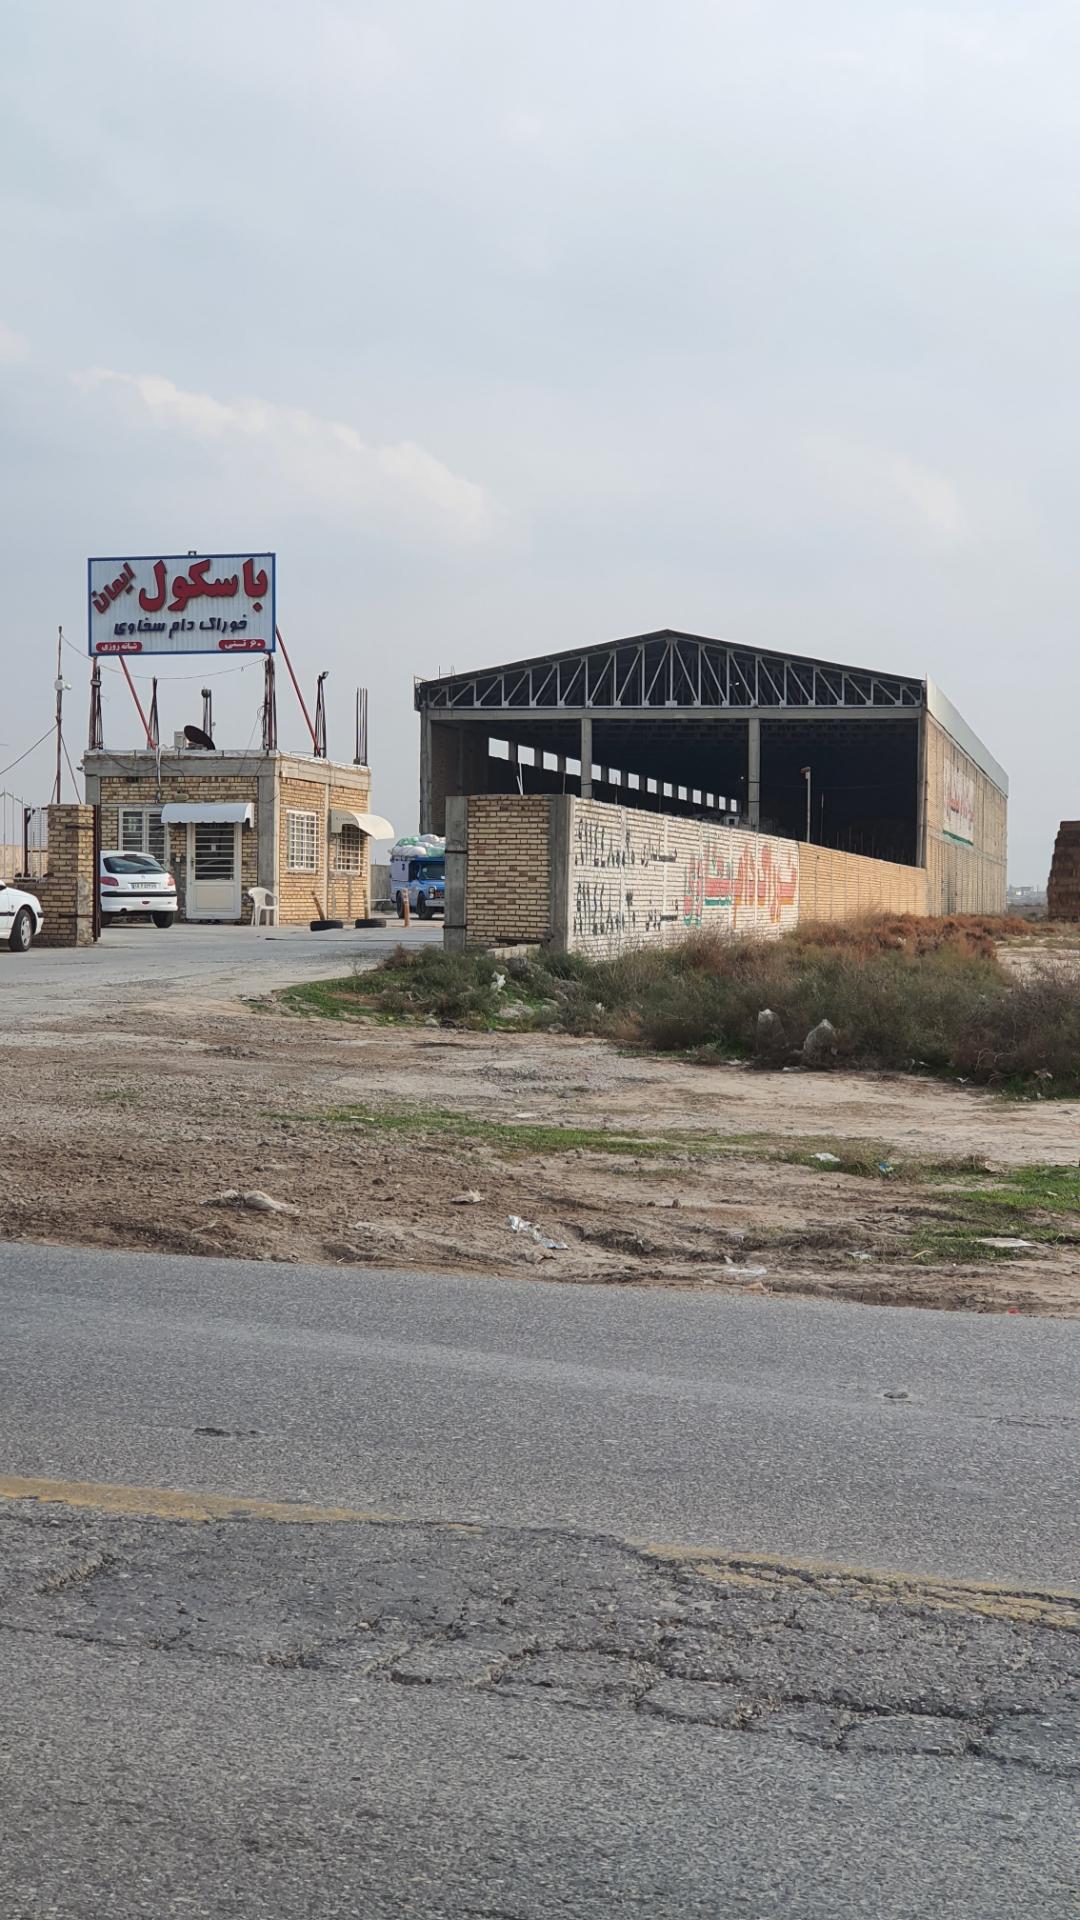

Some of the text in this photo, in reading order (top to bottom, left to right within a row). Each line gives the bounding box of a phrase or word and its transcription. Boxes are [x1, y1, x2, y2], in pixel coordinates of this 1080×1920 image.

[92, 559, 268, 613] باسکول ایمان
[114, 613, 248, 639] خوراک دام سخاوی
